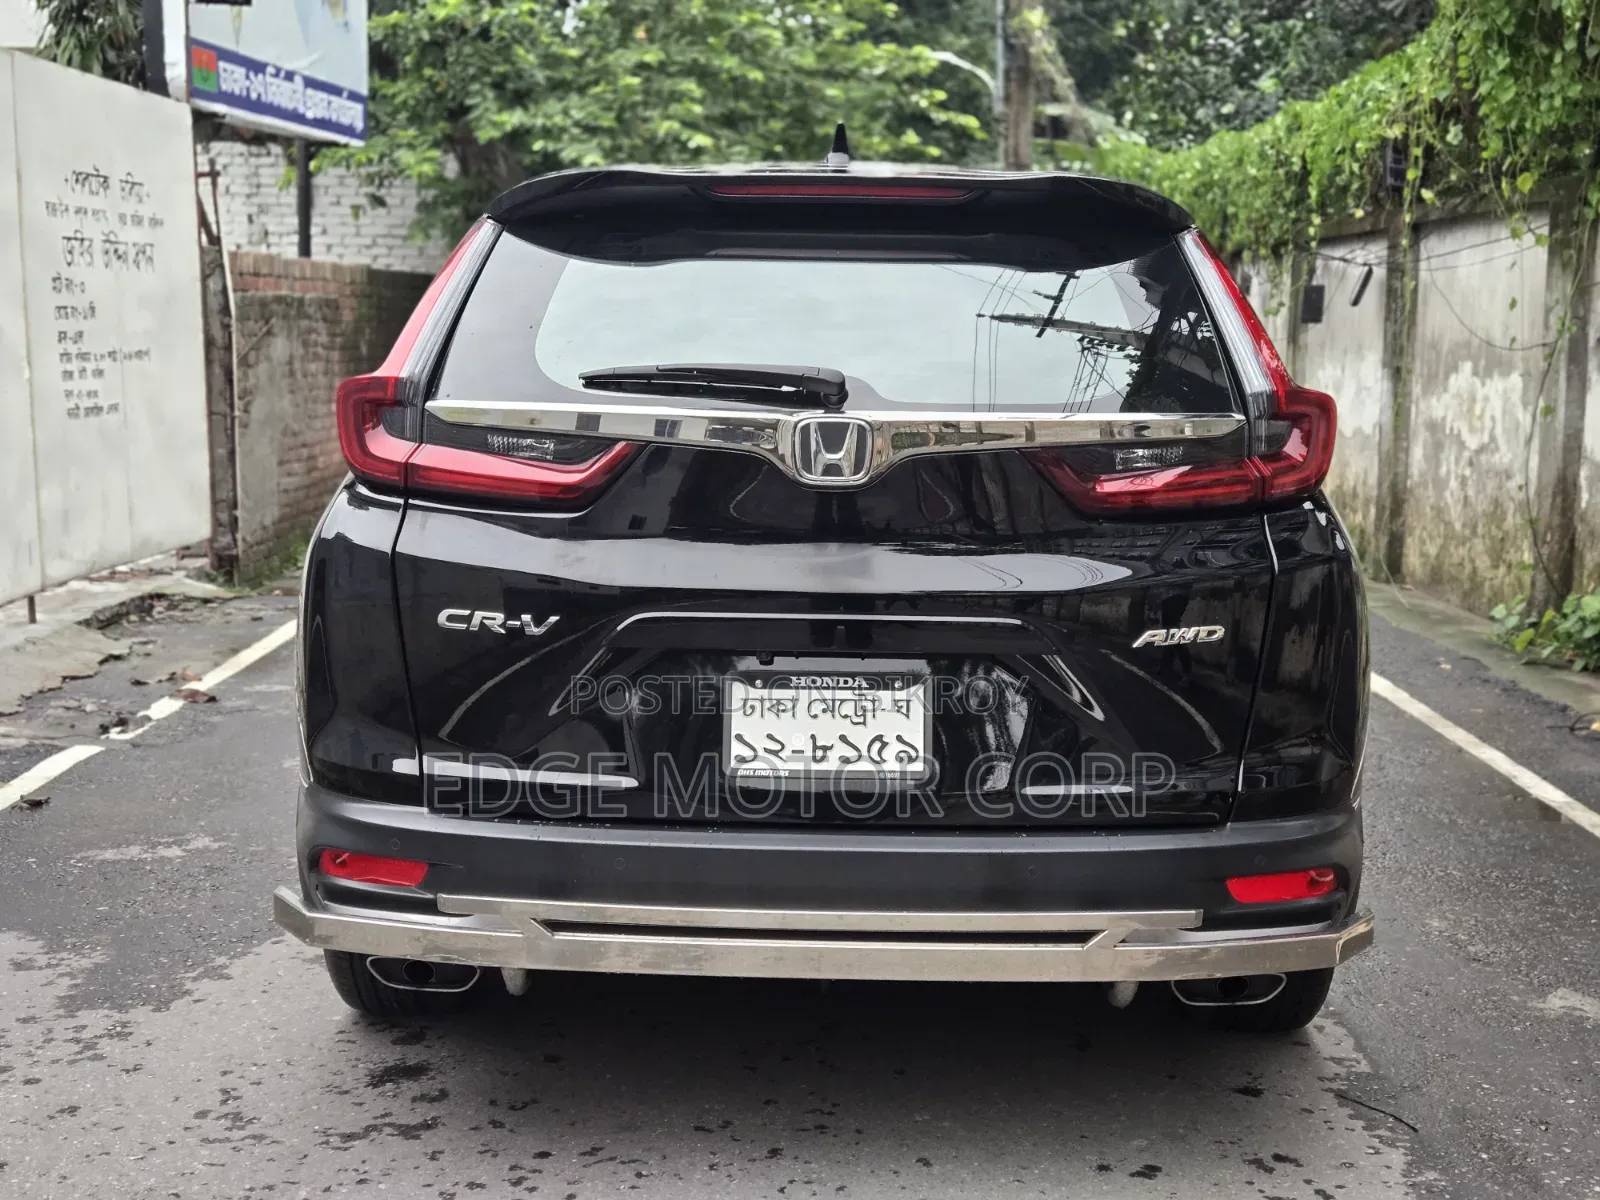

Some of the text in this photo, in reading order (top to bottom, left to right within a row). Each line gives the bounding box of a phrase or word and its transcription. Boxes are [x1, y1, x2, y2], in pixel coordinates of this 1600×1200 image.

[437, 608, 560, 636] CR-V
[1132, 625, 1226, 648] AWD
[790, 676, 869, 688] HONDA
[741, 695, 799, 720] ঢাকা
[734, 733, 920, 764] ১২-৮১৫৯
